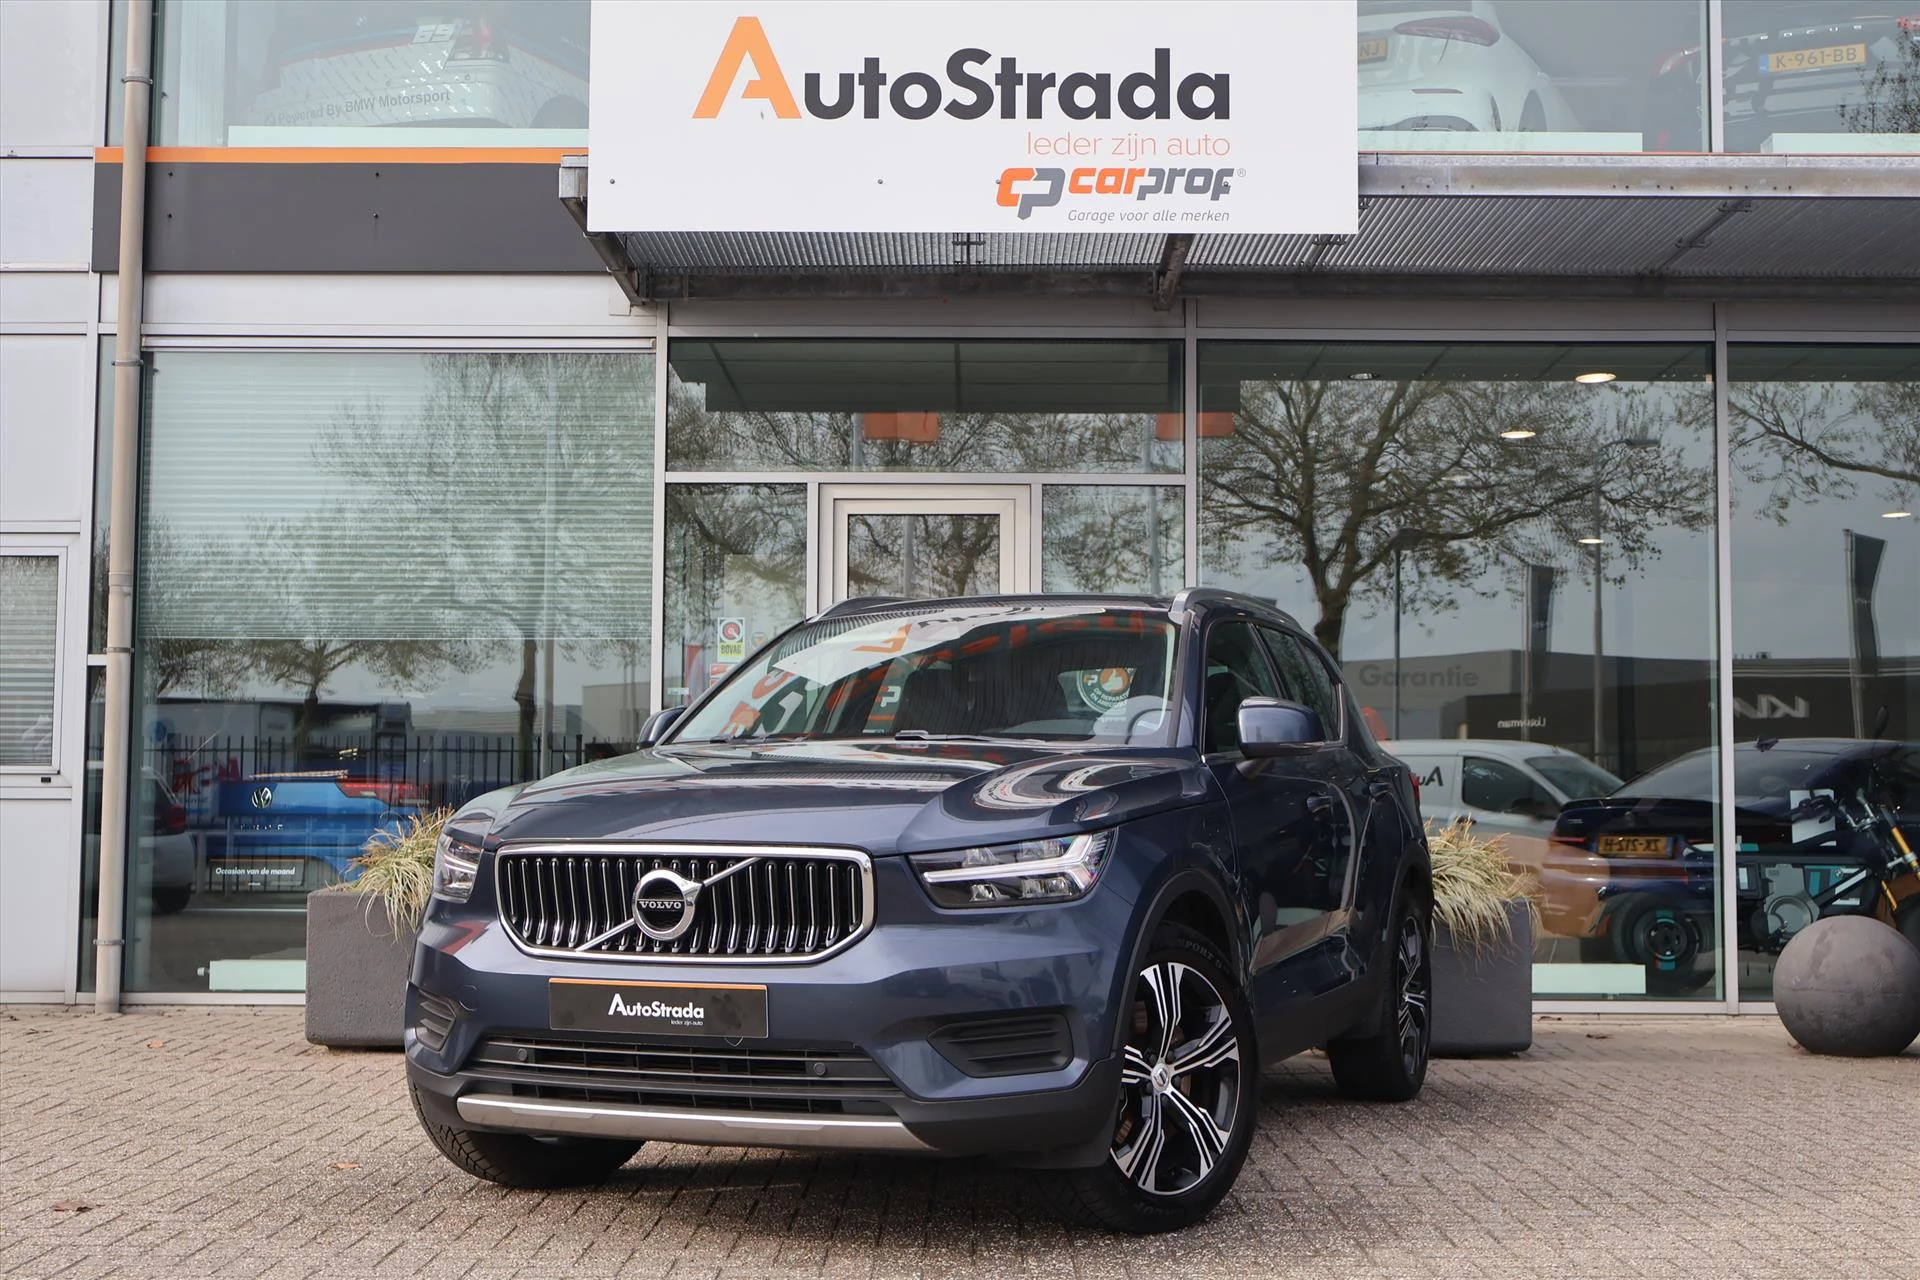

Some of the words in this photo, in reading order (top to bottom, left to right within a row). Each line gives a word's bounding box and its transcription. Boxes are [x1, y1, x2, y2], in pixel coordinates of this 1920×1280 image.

[413, 24, 455, 43] 69
[692, 16, 1230, 120] AutoStrada
[1775, 47, 1857, 69] K-961-BB
[278, 105, 323, 125] Powered
[327, 103, 342, 117] By
[345, 98, 376, 113] BMW
[379, 90, 451, 108] Motorsport
[1111, 132, 1156, 161] zijn
[1167, 133, 1230, 155] auto
[1068, 168, 1235, 201] carprof
[1067, 209, 1115, 224] Garage
[1119, 212, 1149, 221] voor
[1152, 209, 1177, 221] alle
[1180, 209, 1230, 221] merken
[720, 644, 742, 655] BOVAG
[1359, 664, 1479, 687] Garantie
[215, 867, 245, 875] Occasion
[260, 867, 269, 875] de
[270, 867, 296, 875] maand
[639, 901, 682, 909] VOLVO
[608, 993, 704, 1018] AutoStrada
